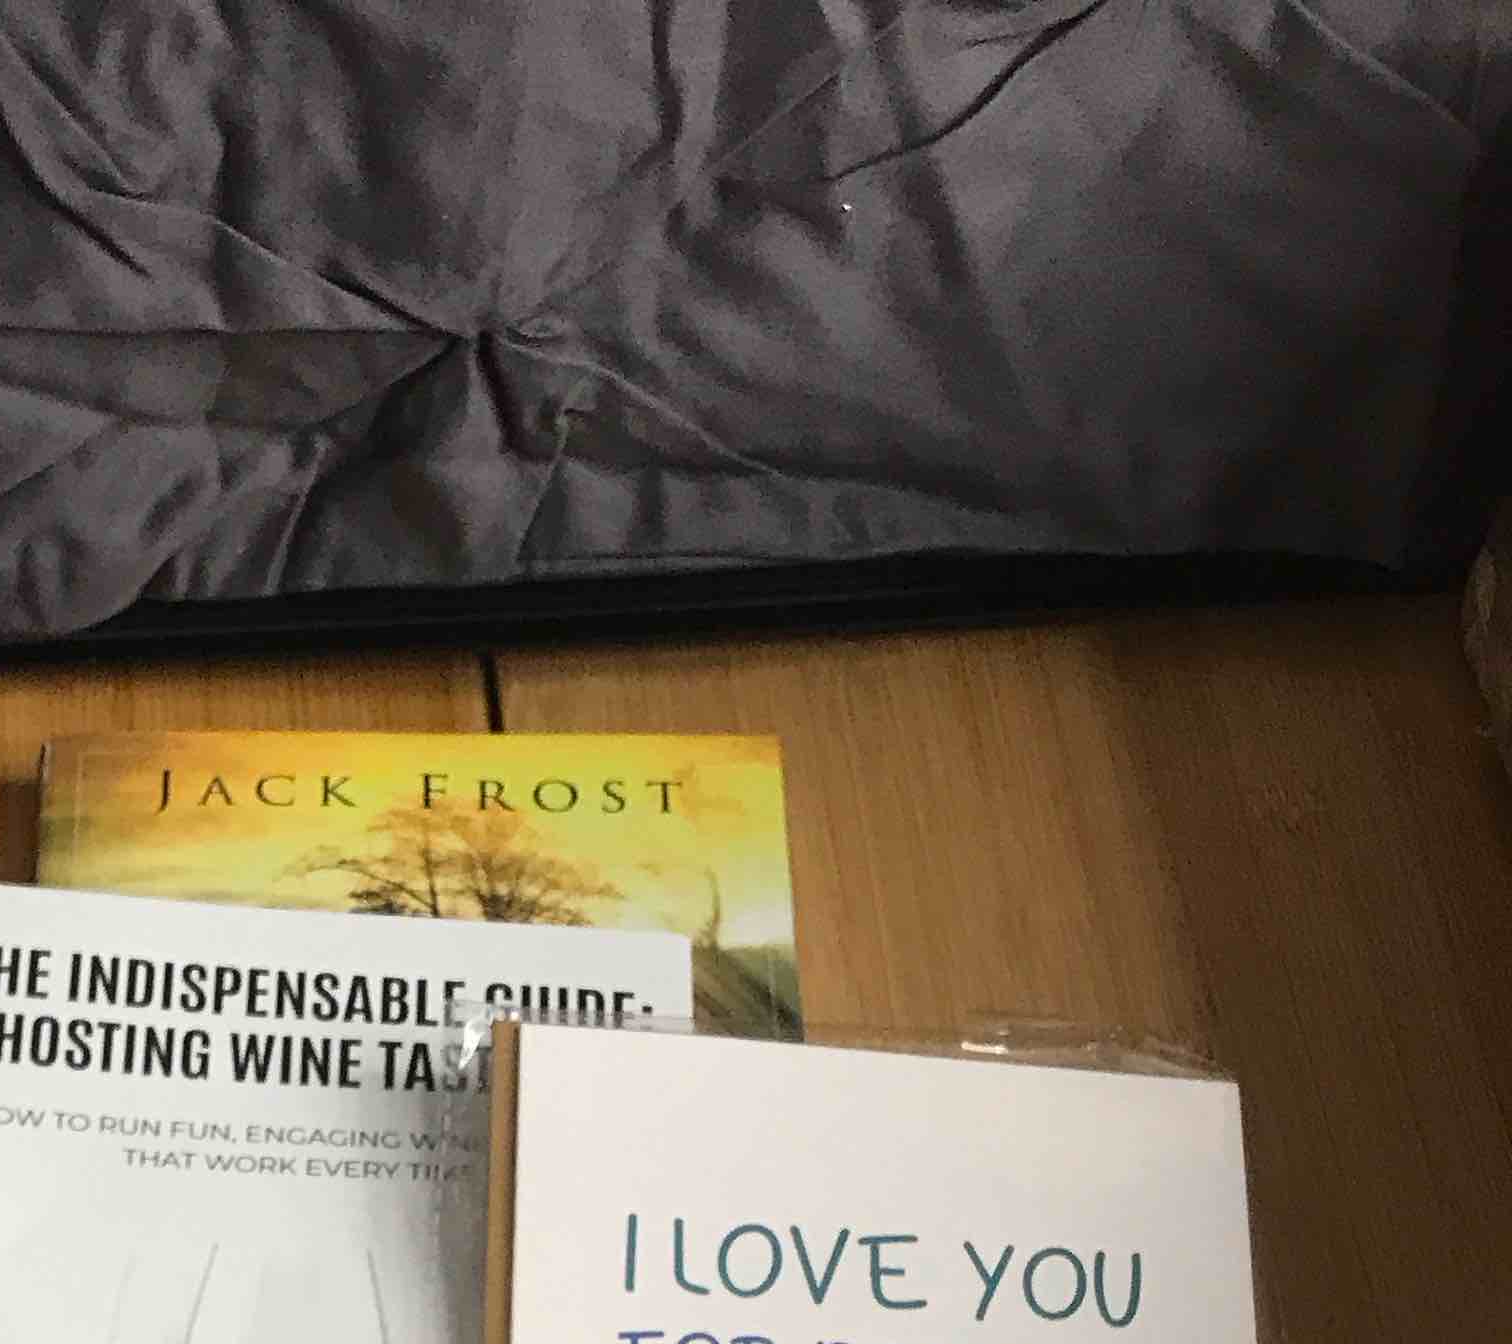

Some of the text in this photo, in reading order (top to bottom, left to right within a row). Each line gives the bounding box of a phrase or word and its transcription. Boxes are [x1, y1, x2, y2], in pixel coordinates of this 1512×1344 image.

[152, 769, 684, 815] JACK FROST
[67, 952, 468, 1030] INDISPENSABLE
[230, 1030, 365, 1090] WINE
[52, 1111, 92, 1133] TO
[98, 1114, 162, 1138] RUN
[169, 1119, 238, 1144] FUN,
[245, 1124, 403, 1152] ENGAGING
[122, 1148, 198, 1170] THAT
[204, 1152, 300, 1177] WORK
[305, 1157, 402, 1180] EVERY
[624, 1213, 1143, 1327] I LOVE YOU
